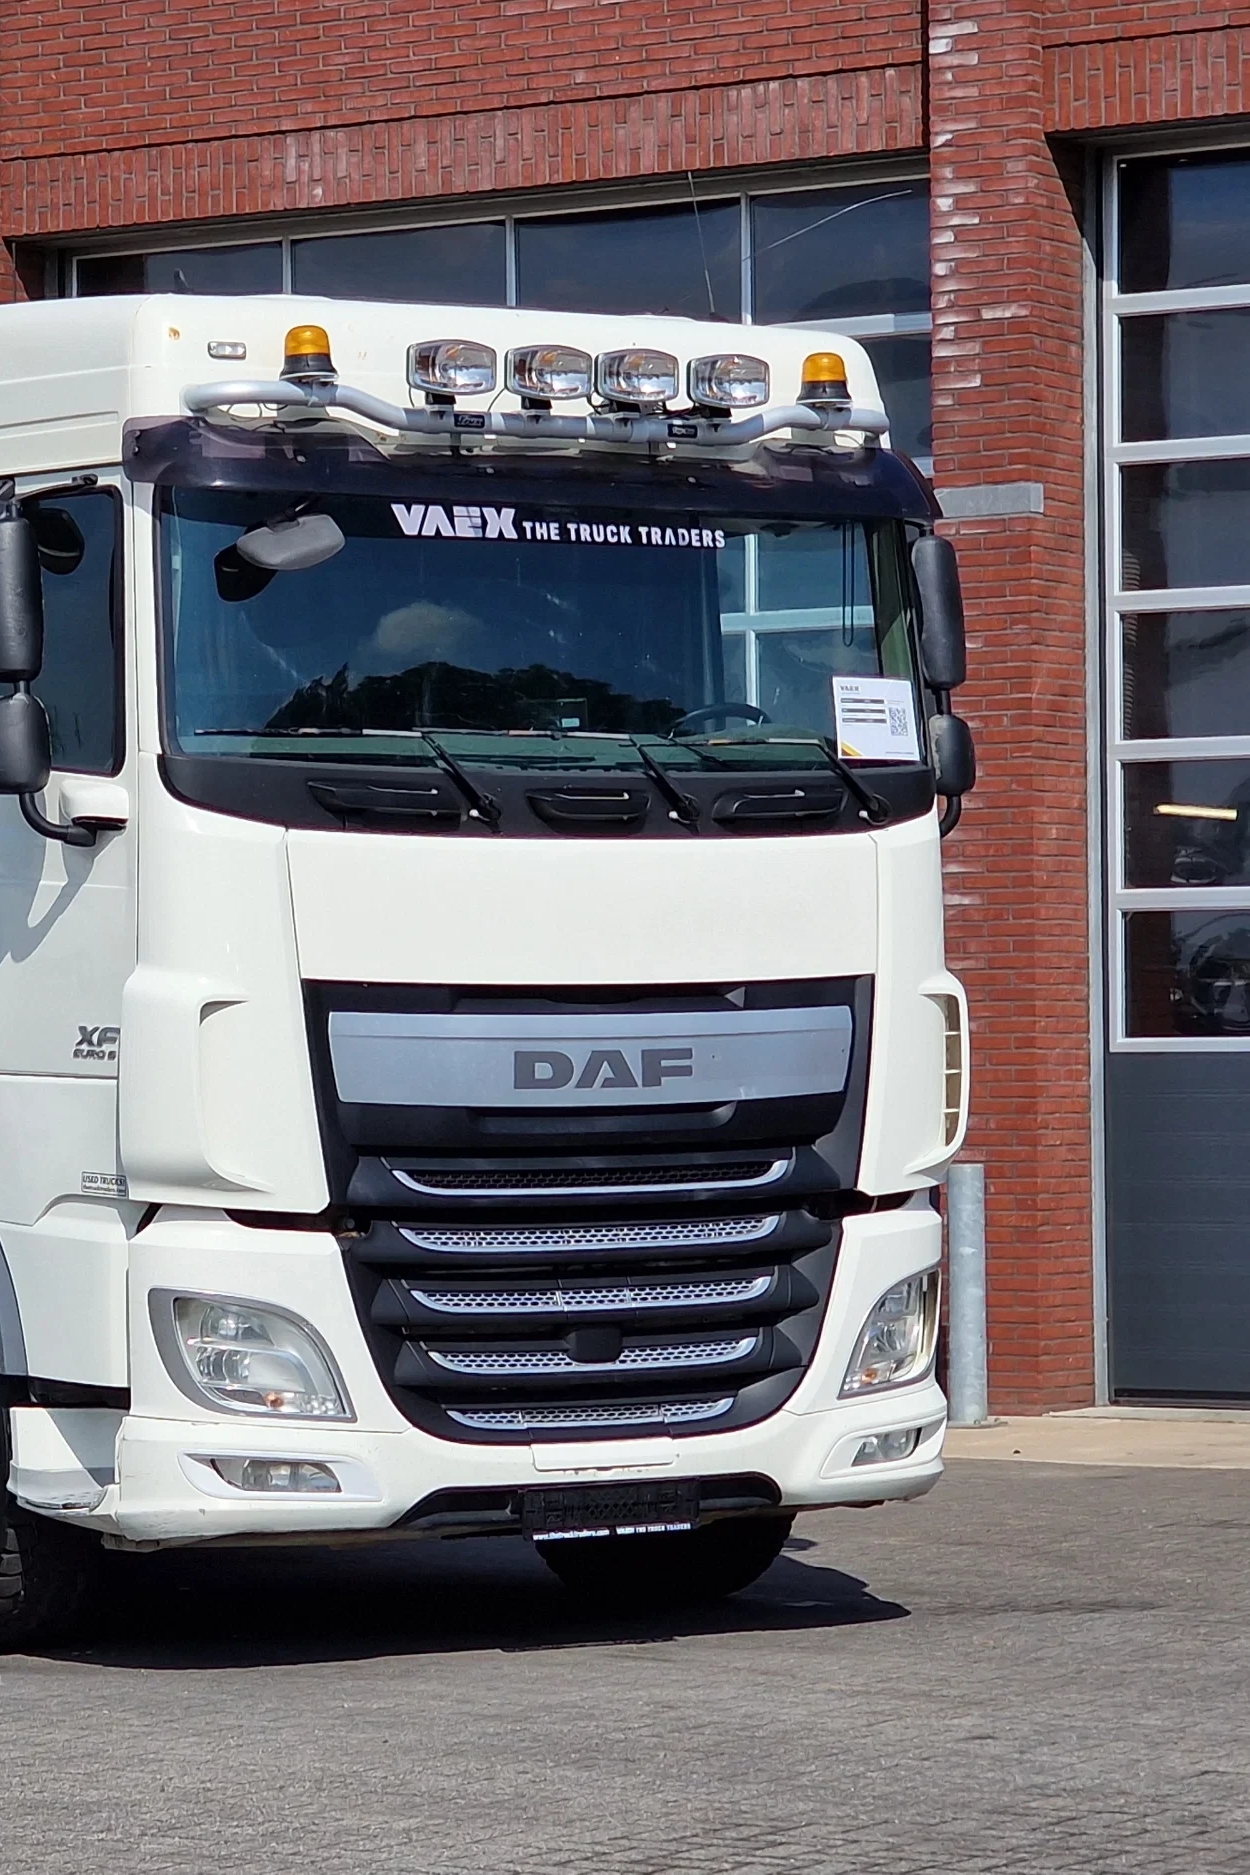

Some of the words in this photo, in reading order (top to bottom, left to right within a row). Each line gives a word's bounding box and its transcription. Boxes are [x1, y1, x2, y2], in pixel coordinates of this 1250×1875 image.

[390, 503, 518, 539] VAEX
[523, 520, 560, 542] THE
[567, 523, 633, 544] TRUCK
[638, 526, 726, 548] TRADERS
[76, 1026, 120, 1048] XF
[73, 1049, 106, 1060] EURO
[513, 1047, 694, 1090] DAF
